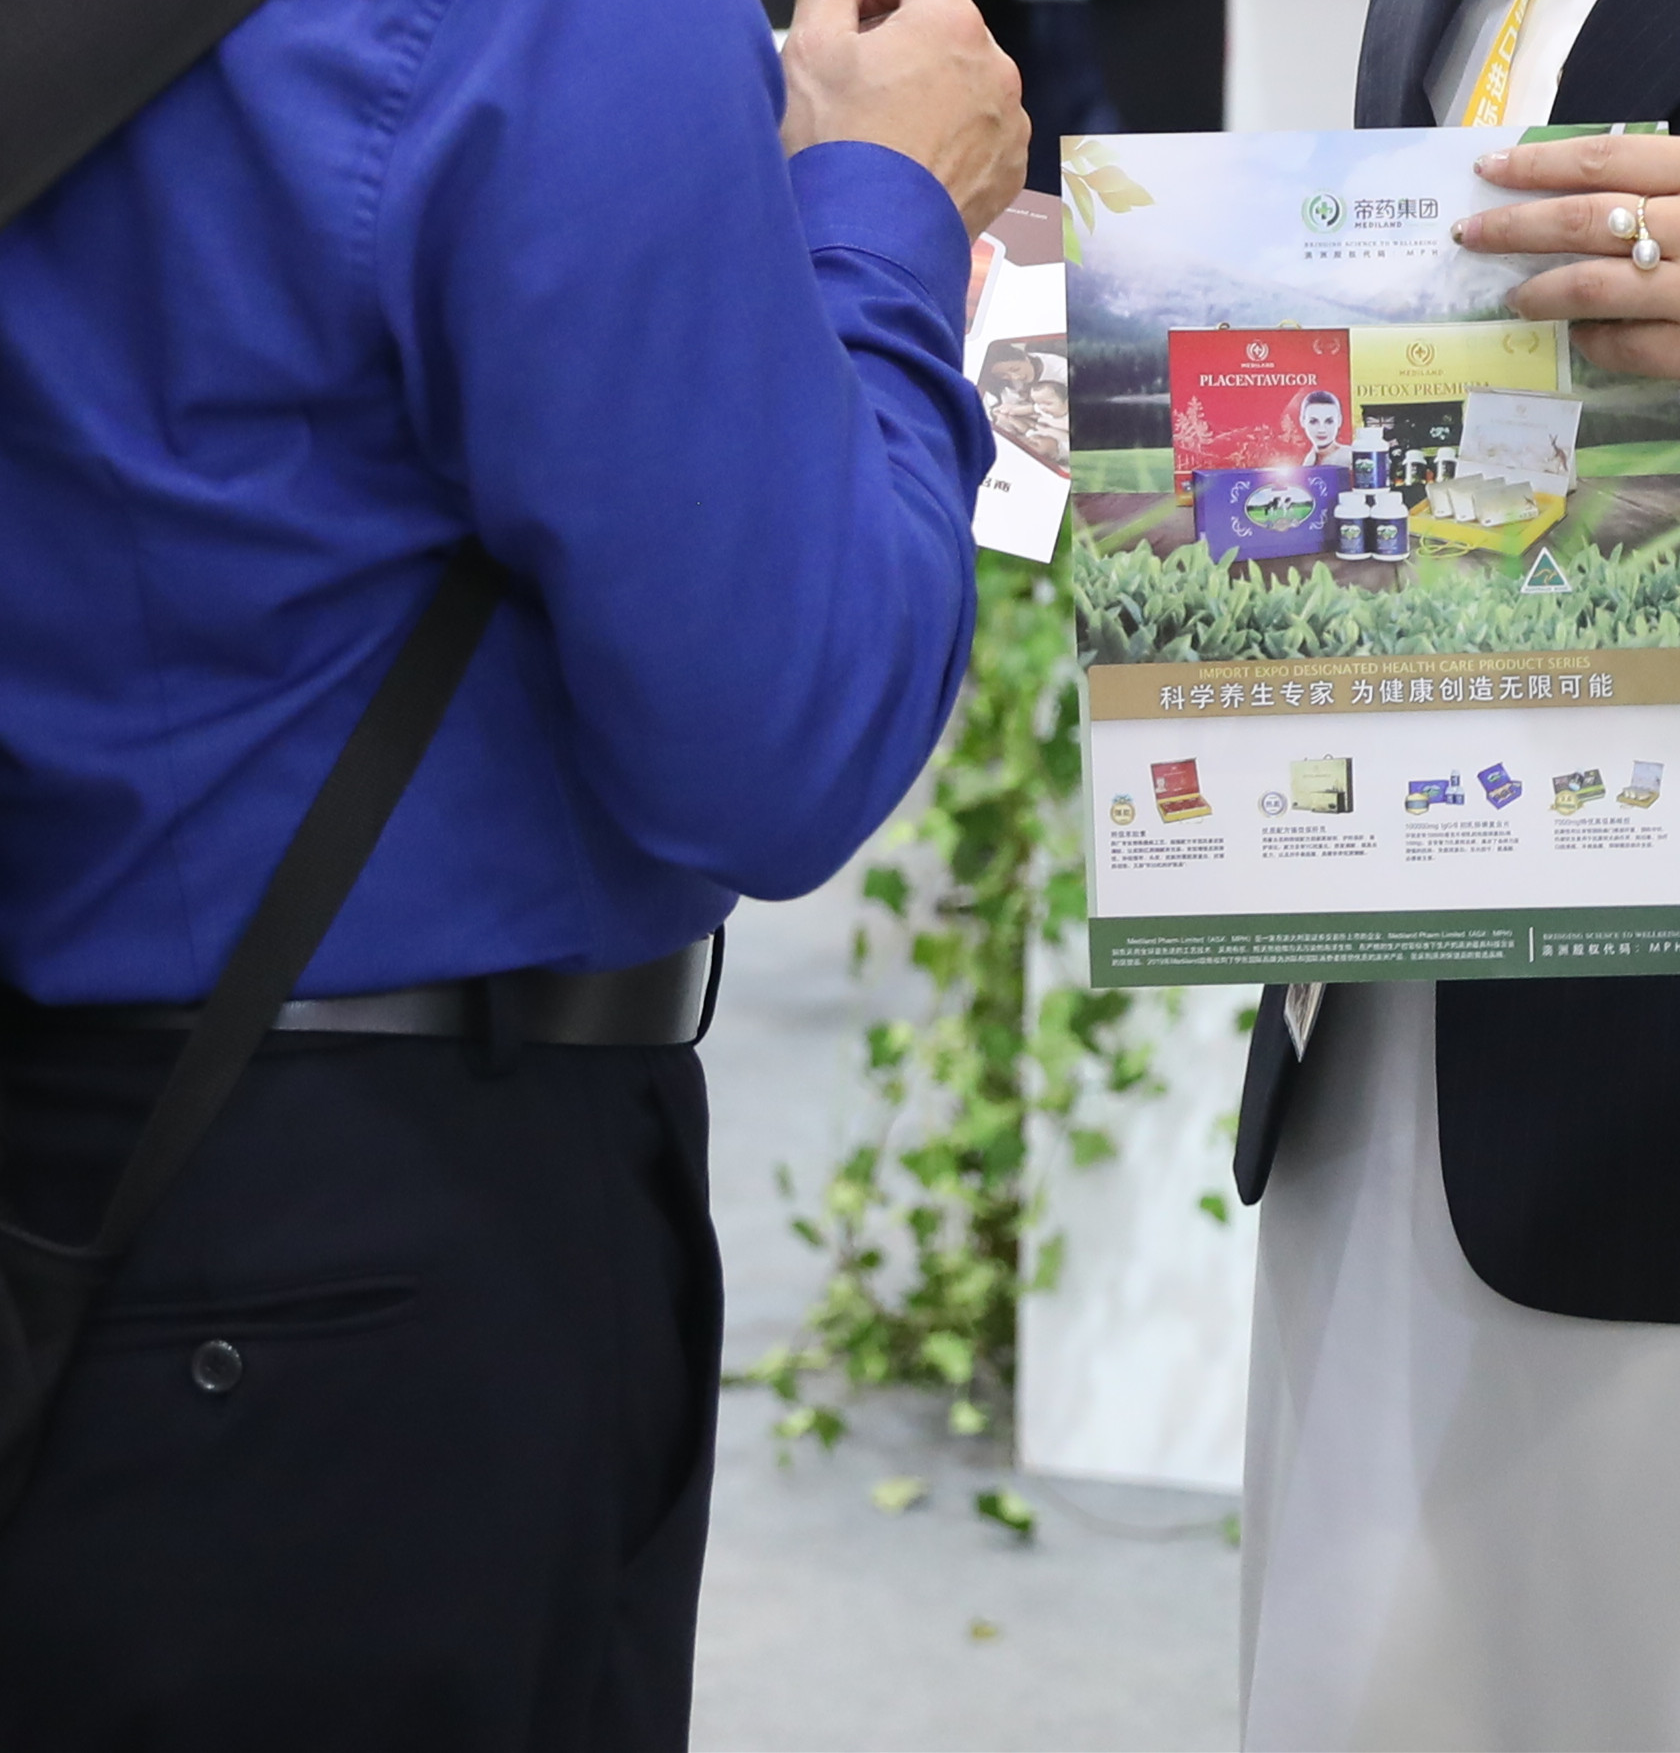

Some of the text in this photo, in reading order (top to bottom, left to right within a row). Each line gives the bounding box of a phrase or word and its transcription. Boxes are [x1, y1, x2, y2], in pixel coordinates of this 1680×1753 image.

[1353, 198, 1439, 220] 帝药集团
[1354, 220, 1403, 229] MEDILAND
[1199, 372, 1318, 388] PLACENTAVIGOR
[1356, 383, 1411, 398] DETOX
[1198, 656, 1591, 680] IMPORT EXPO DESIGNATED HEALTH CARE PRODUCT SERIES
[1159, 671, 1616, 711] 科学养生专家 为健康创造无限可能
